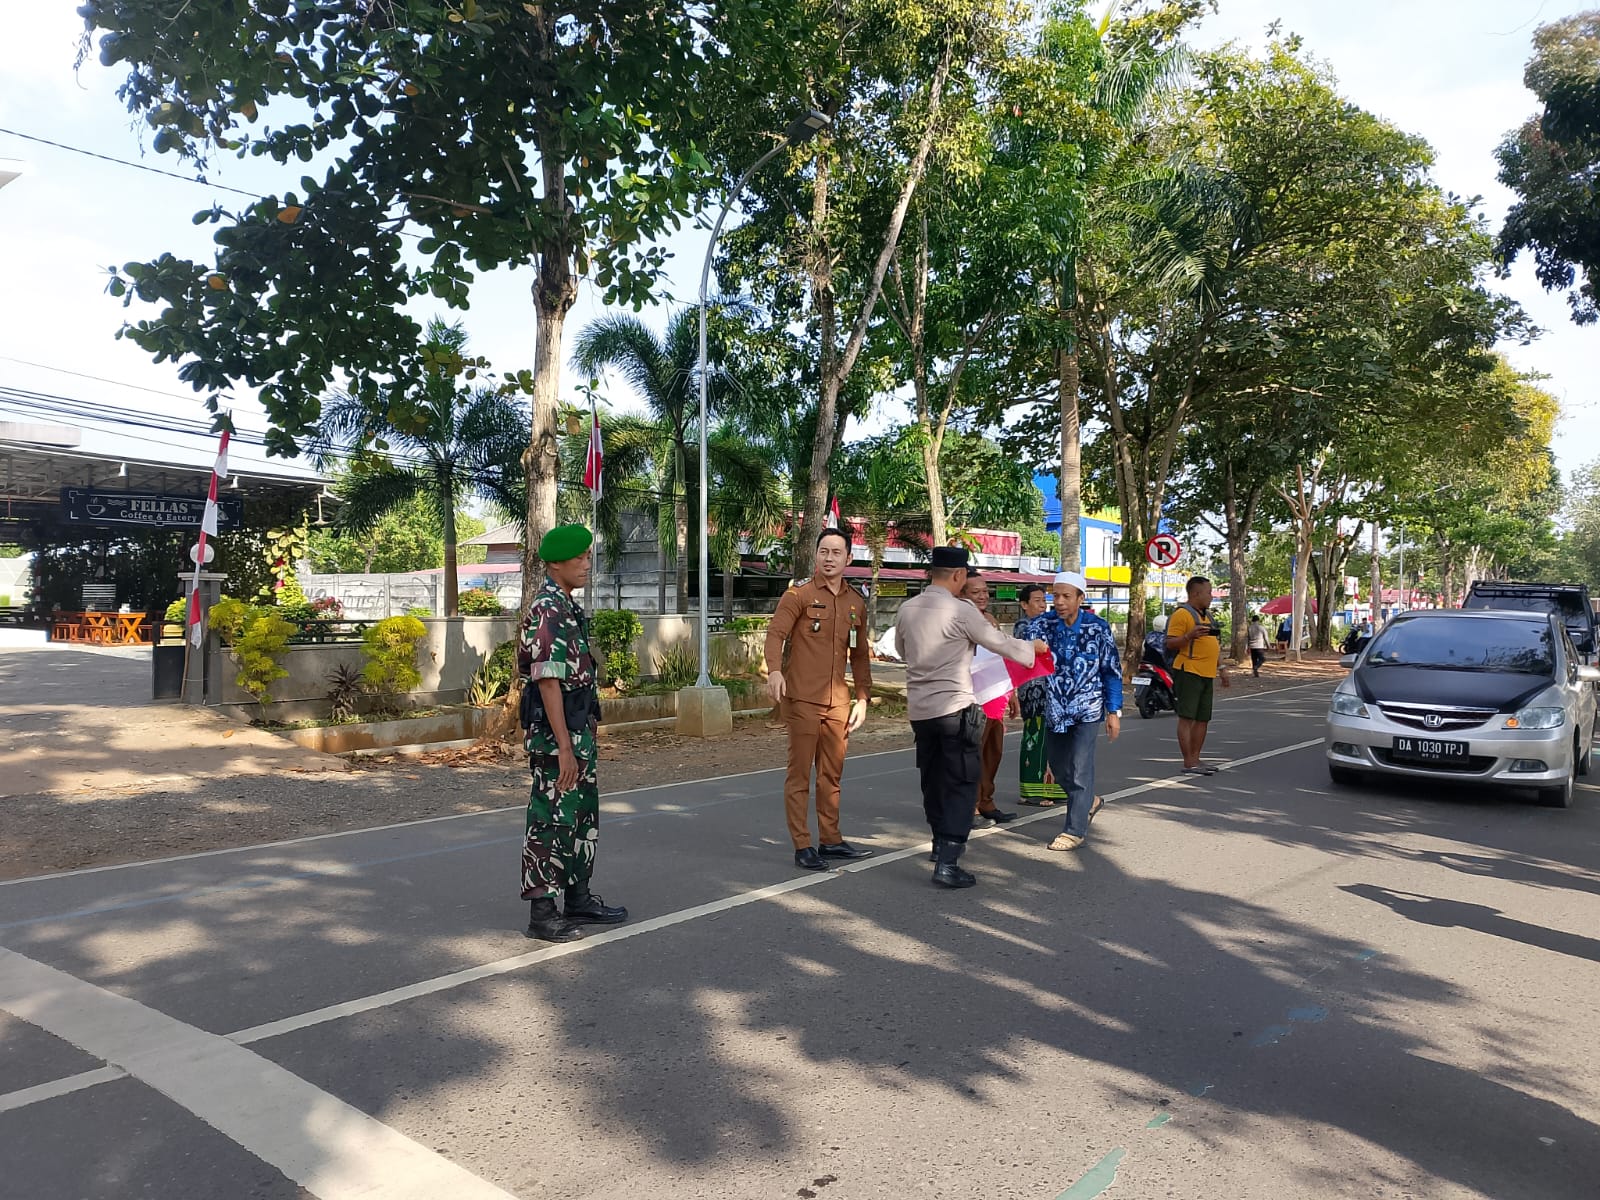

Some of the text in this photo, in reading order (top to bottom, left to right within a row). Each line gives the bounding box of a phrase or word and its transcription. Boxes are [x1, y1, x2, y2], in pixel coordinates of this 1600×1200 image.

[131, 500, 188, 513] FELLAS
[120, 510, 197, 523] Coffee & Eatery
[1399, 739, 1412, 751] DA
[1418, 740, 1442, 754] 1030
[1444, 743, 1464, 756] TPJ
